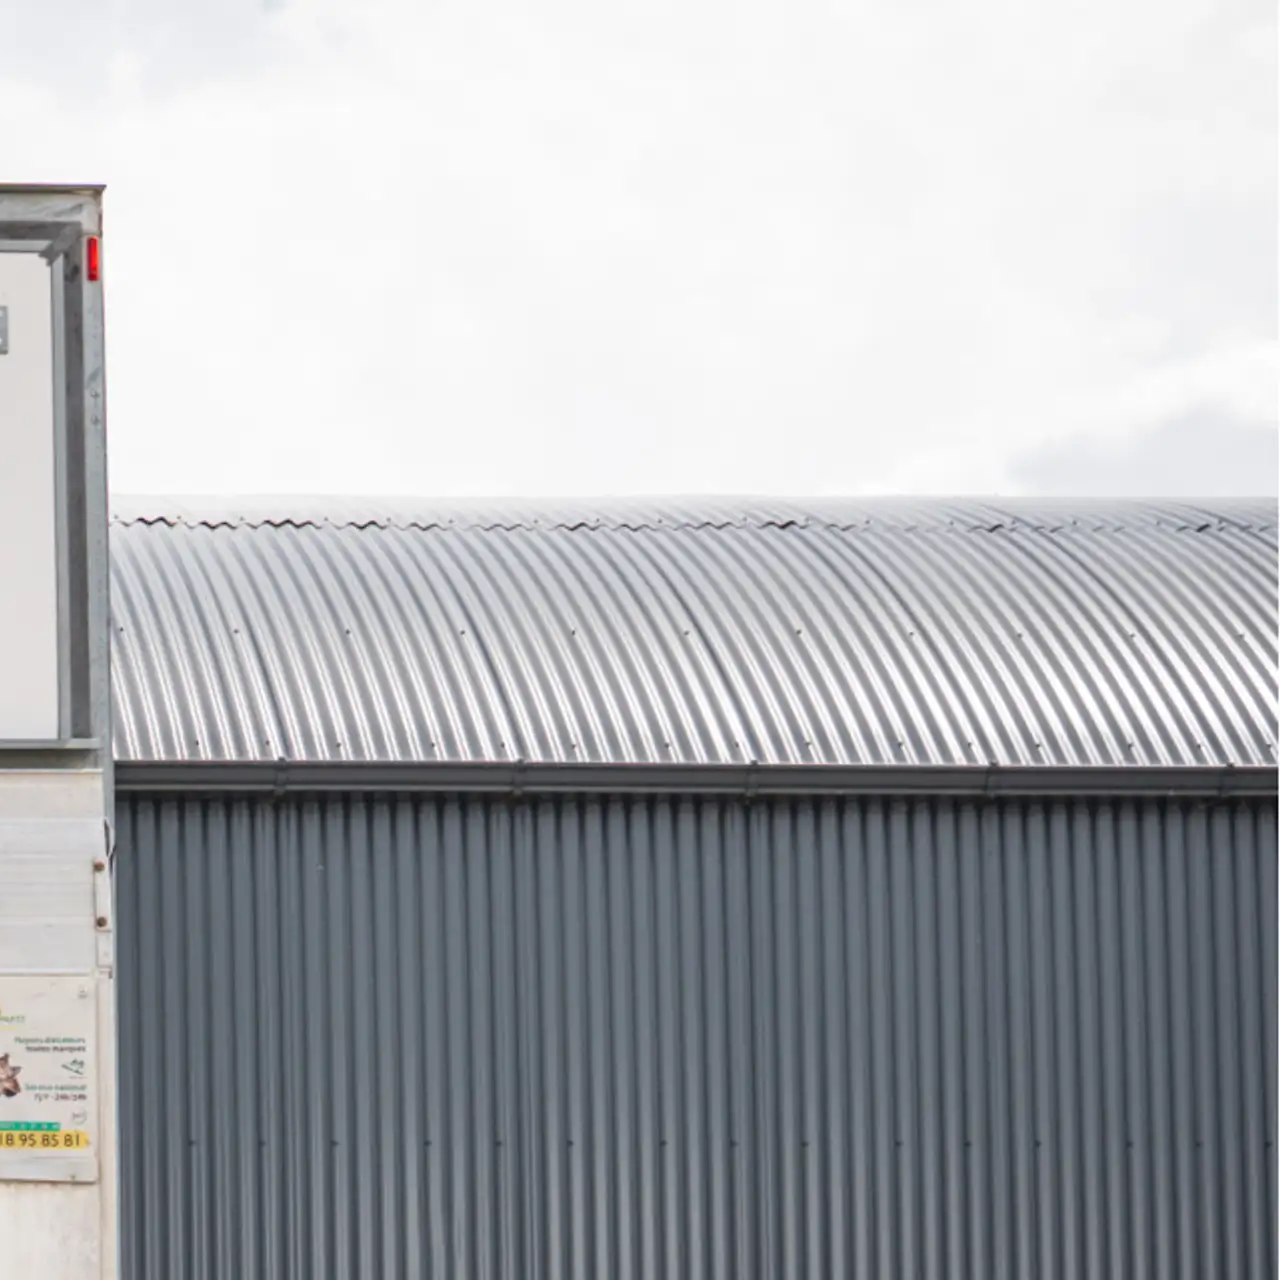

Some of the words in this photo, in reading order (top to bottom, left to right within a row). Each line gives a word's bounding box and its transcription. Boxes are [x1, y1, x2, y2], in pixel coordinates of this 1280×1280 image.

[20, 1132, 37, 1147] 95
[41, 1132, 59, 1147] 85
[64, 1132, 80, 1147] 81
